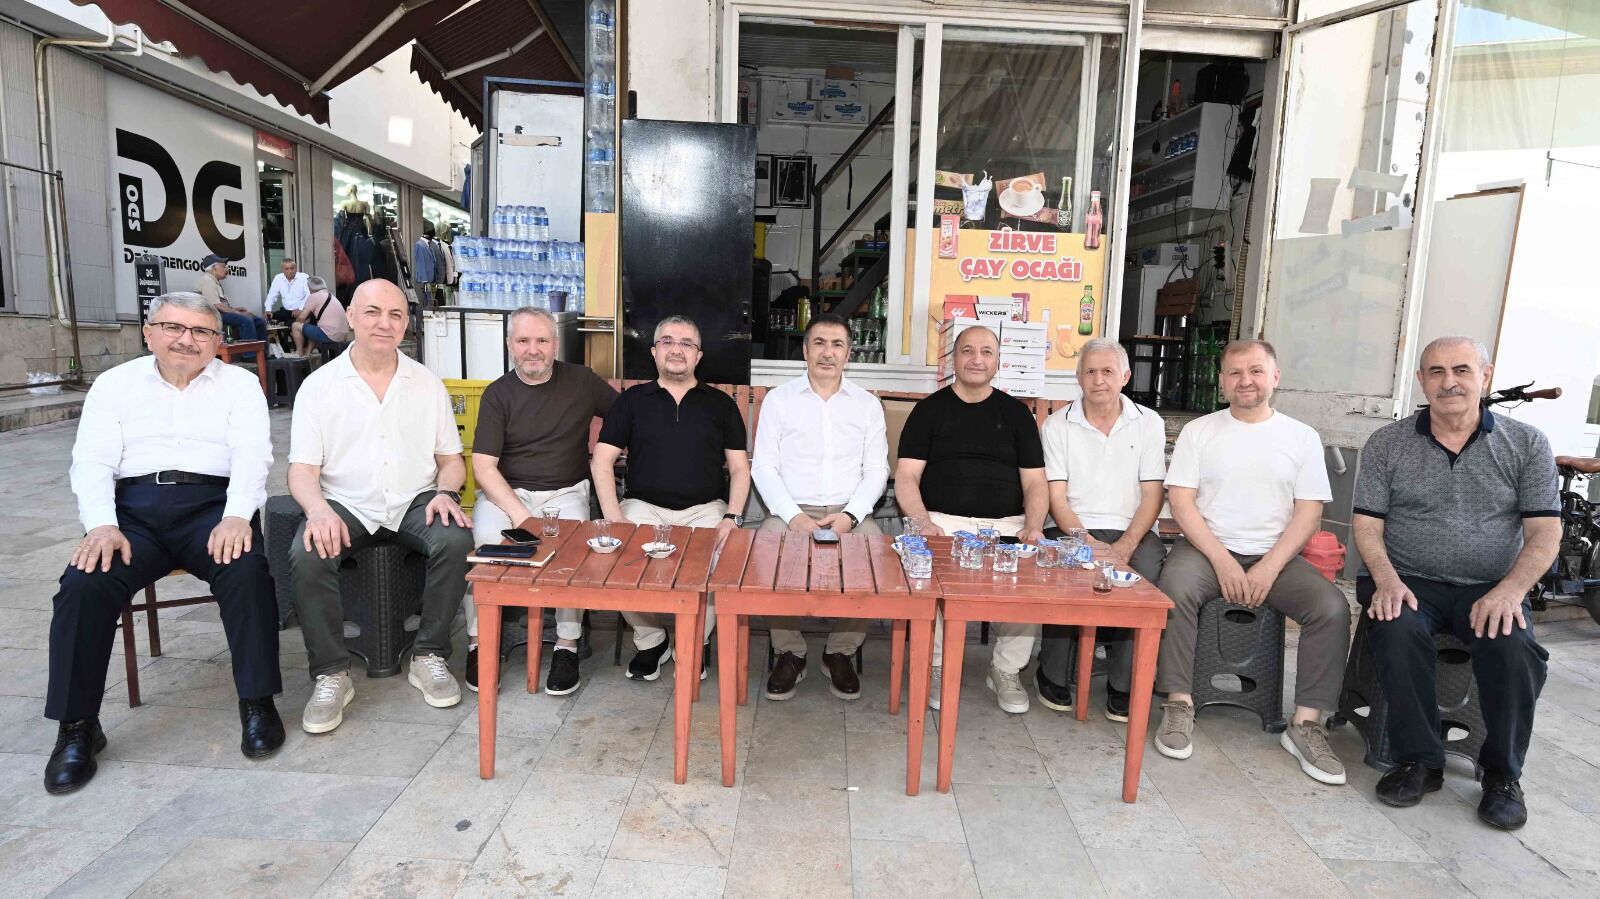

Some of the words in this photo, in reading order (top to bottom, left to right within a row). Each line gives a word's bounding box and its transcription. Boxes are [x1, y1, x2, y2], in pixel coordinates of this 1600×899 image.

[116, 128, 246, 261] DG
[126, 184, 142, 232] SDO
[989, 226, 1056, 252] ZİRVE
[960, 258, 1005, 280] ÇAY
[1011, 257, 1081, 279] OCAĞI
